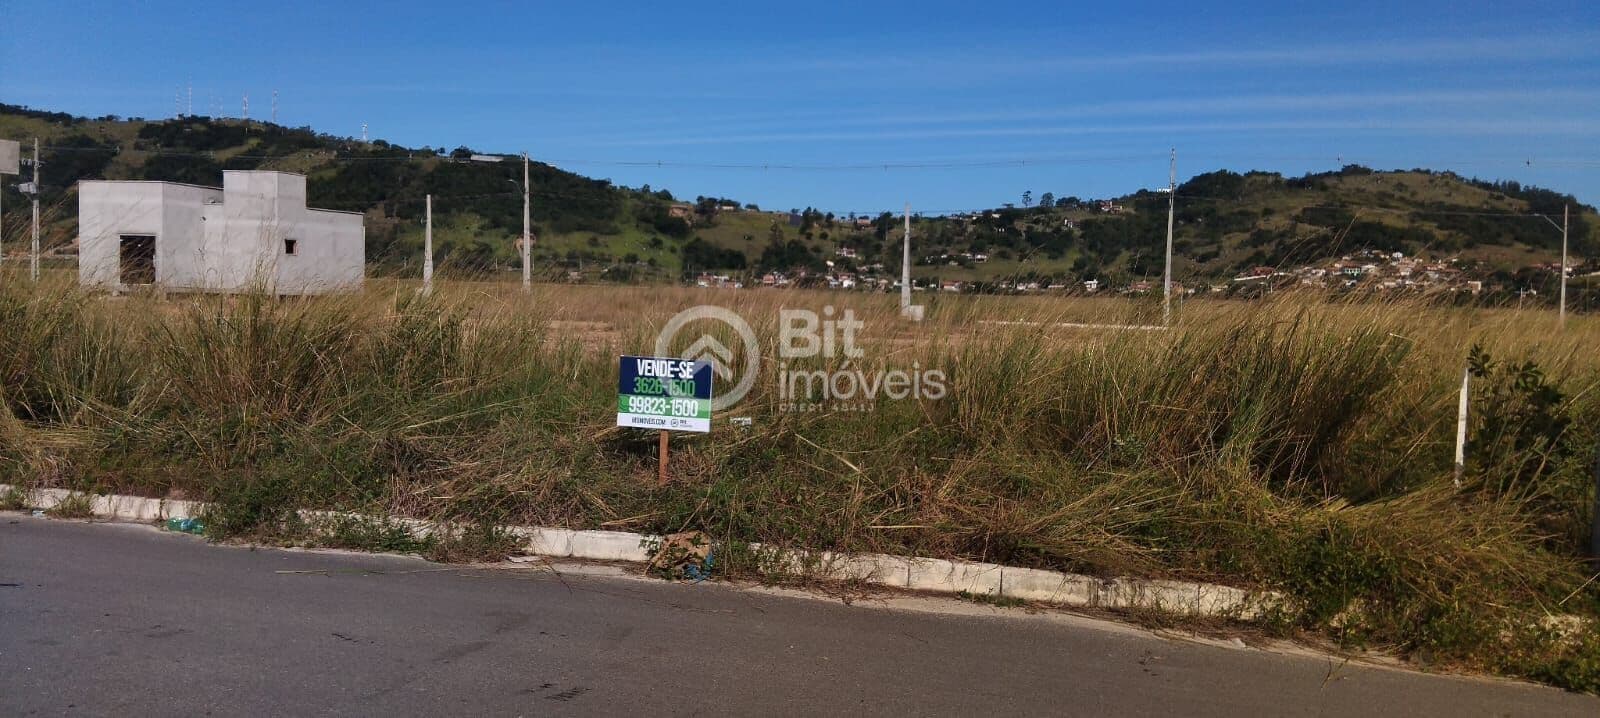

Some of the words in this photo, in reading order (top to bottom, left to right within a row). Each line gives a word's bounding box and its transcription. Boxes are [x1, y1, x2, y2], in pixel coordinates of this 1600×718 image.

[637, 359, 695, 379] VENDE-SE
[633, 376, 696, 397] 3626-1500
[628, 396, 699, 417] 99823-1500
